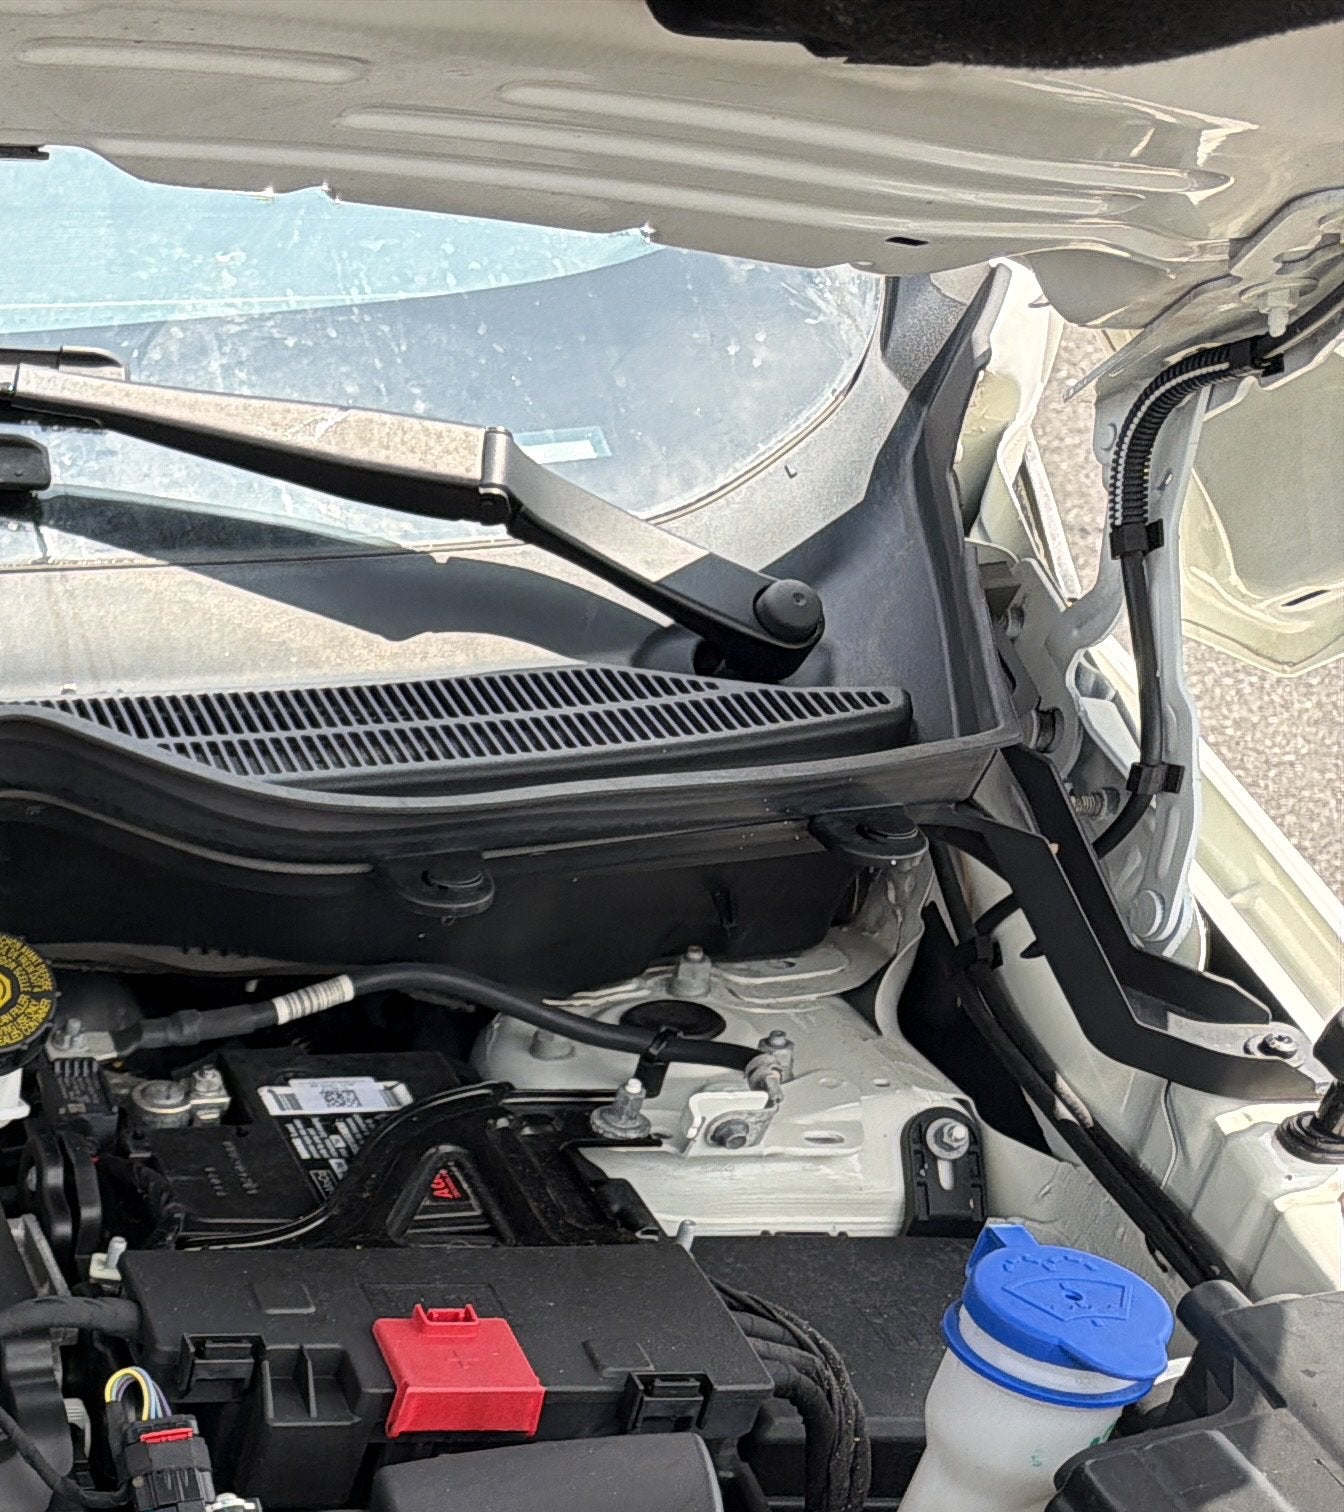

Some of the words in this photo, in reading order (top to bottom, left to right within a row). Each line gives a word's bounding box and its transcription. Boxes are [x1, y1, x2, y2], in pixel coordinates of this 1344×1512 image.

[7, 945, 22, 958] DE
[17, 952, 38, 972] FREIN
[29, 970, 43, 985] DOT
[20, 942, 45, 965] AVANT
[9, 993, 31, 1019] FILLER
[12, 1013, 30, 1028] USE
[22, 998, 40, 1018] ONLY
[19, 997, 52, 1036] CONTAINER
